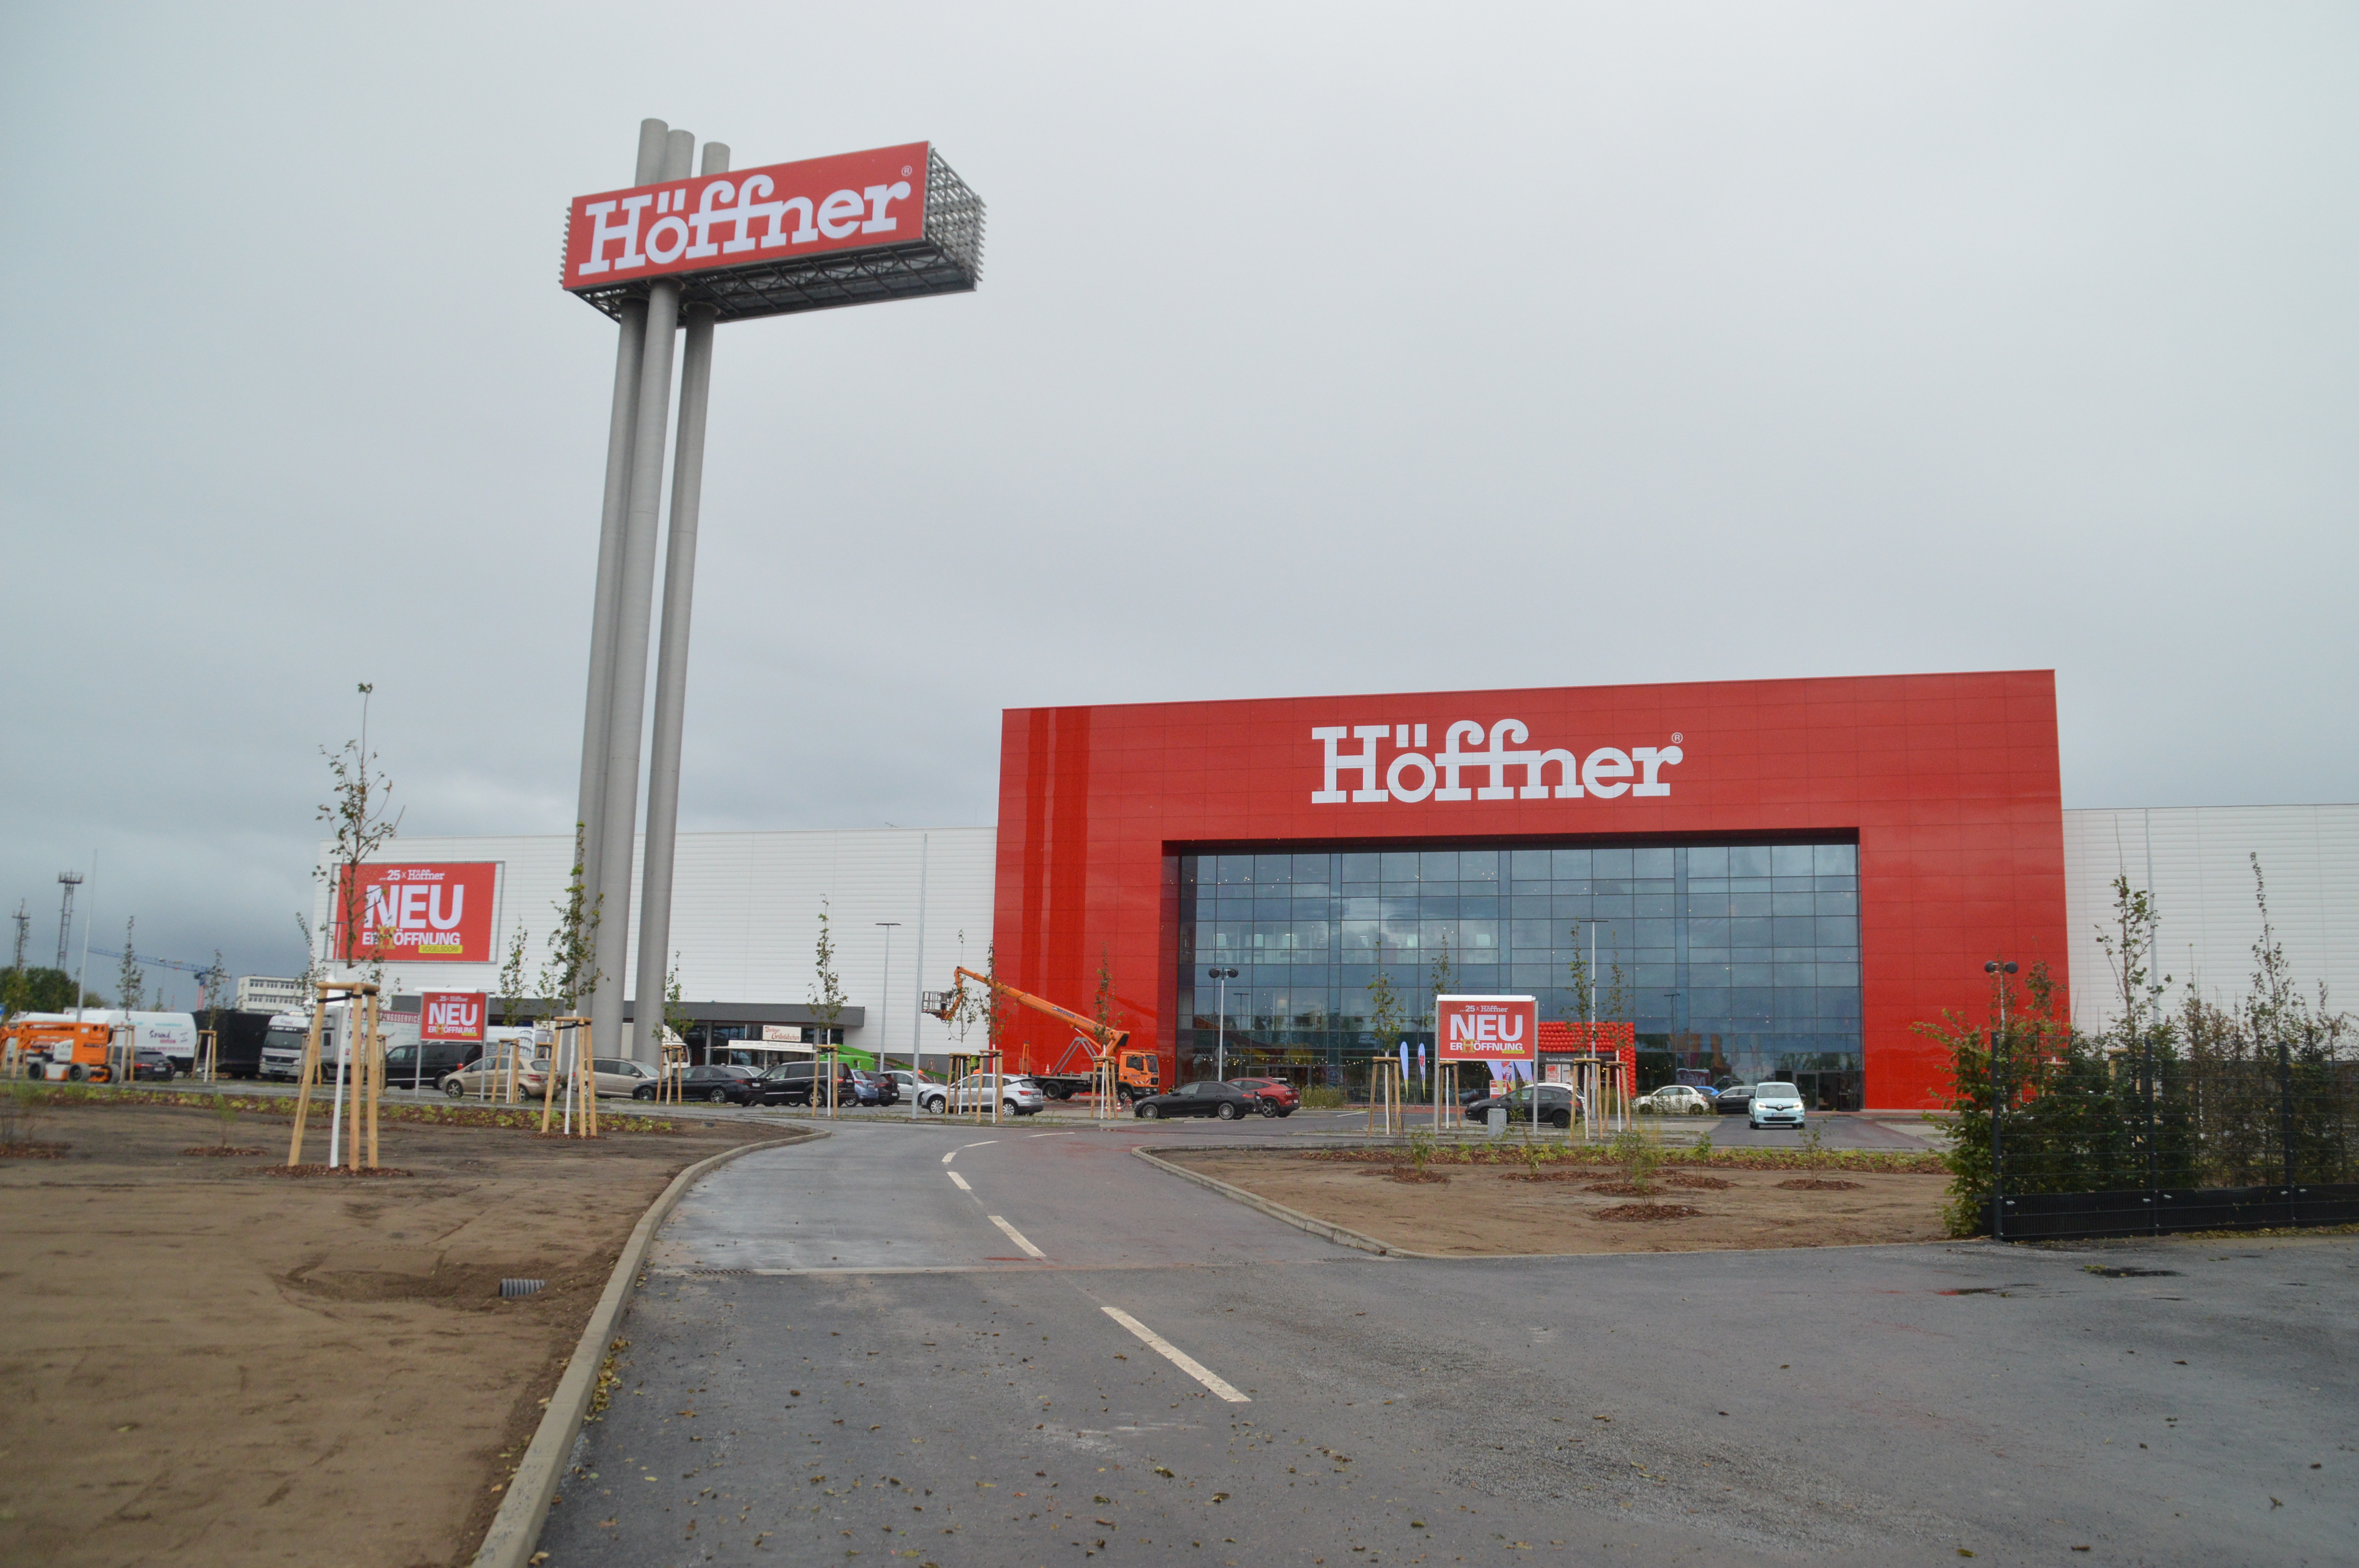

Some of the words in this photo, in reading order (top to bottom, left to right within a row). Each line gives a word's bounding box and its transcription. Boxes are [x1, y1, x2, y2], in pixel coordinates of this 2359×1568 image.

[579, 175, 911, 275] Höffner
[1312, 719, 1683, 803] Höffner
[387, 869, 400, 881] 25
[407, 869, 444, 880] Höffner
[363, 884, 464, 929] NEU
[428, 1003, 478, 1026] NEU
[150, 1030, 171, 1039] Sound
[428, 1023, 476, 1035] ERHÖFFNUNG
[771, 1032, 800, 1041] Grillstübchen
[1450, 1014, 1523, 1041] NEU
[1450, 1039, 1523, 1053] ERHÖFFNUNG
